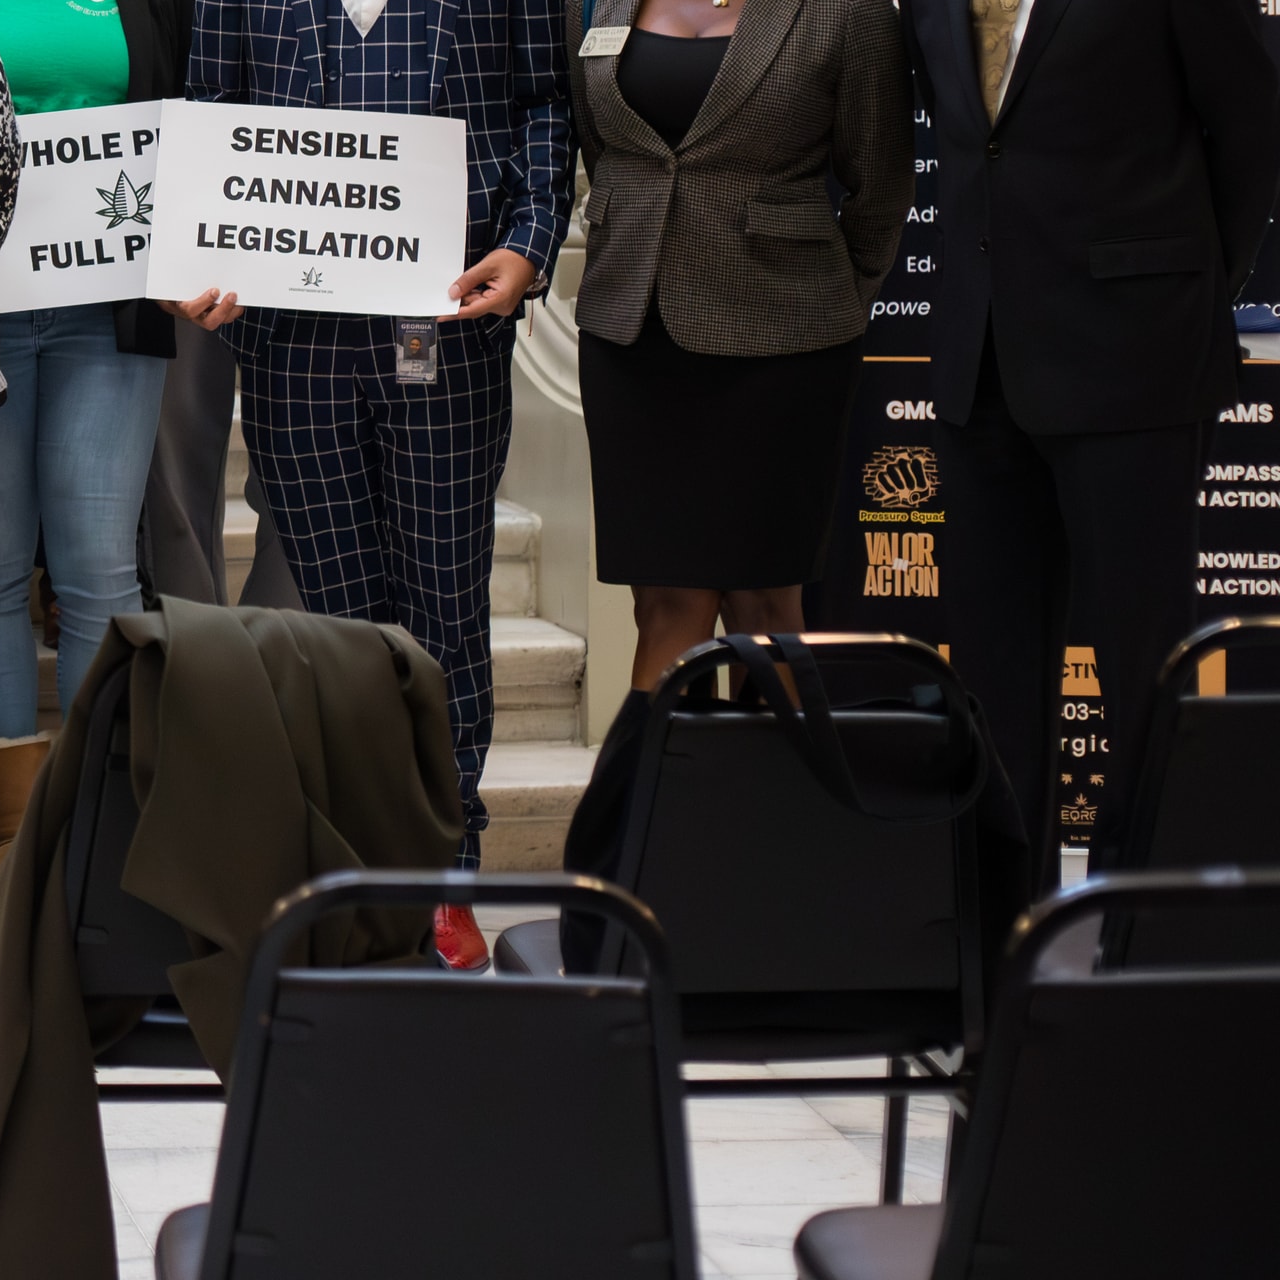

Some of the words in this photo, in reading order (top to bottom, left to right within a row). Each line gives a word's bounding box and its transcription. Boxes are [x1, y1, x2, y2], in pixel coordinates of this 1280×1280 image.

[21, 132, 123, 169] HOLE
[230, 126, 399, 161] SENSIBLE
[223, 176, 401, 211] CANNABIS
[30, 238, 115, 272] FULL
[197, 223, 420, 263] LEGISLATION
[860, 511, 909, 522] Pressure
[865, 532, 935, 566] VALOR
